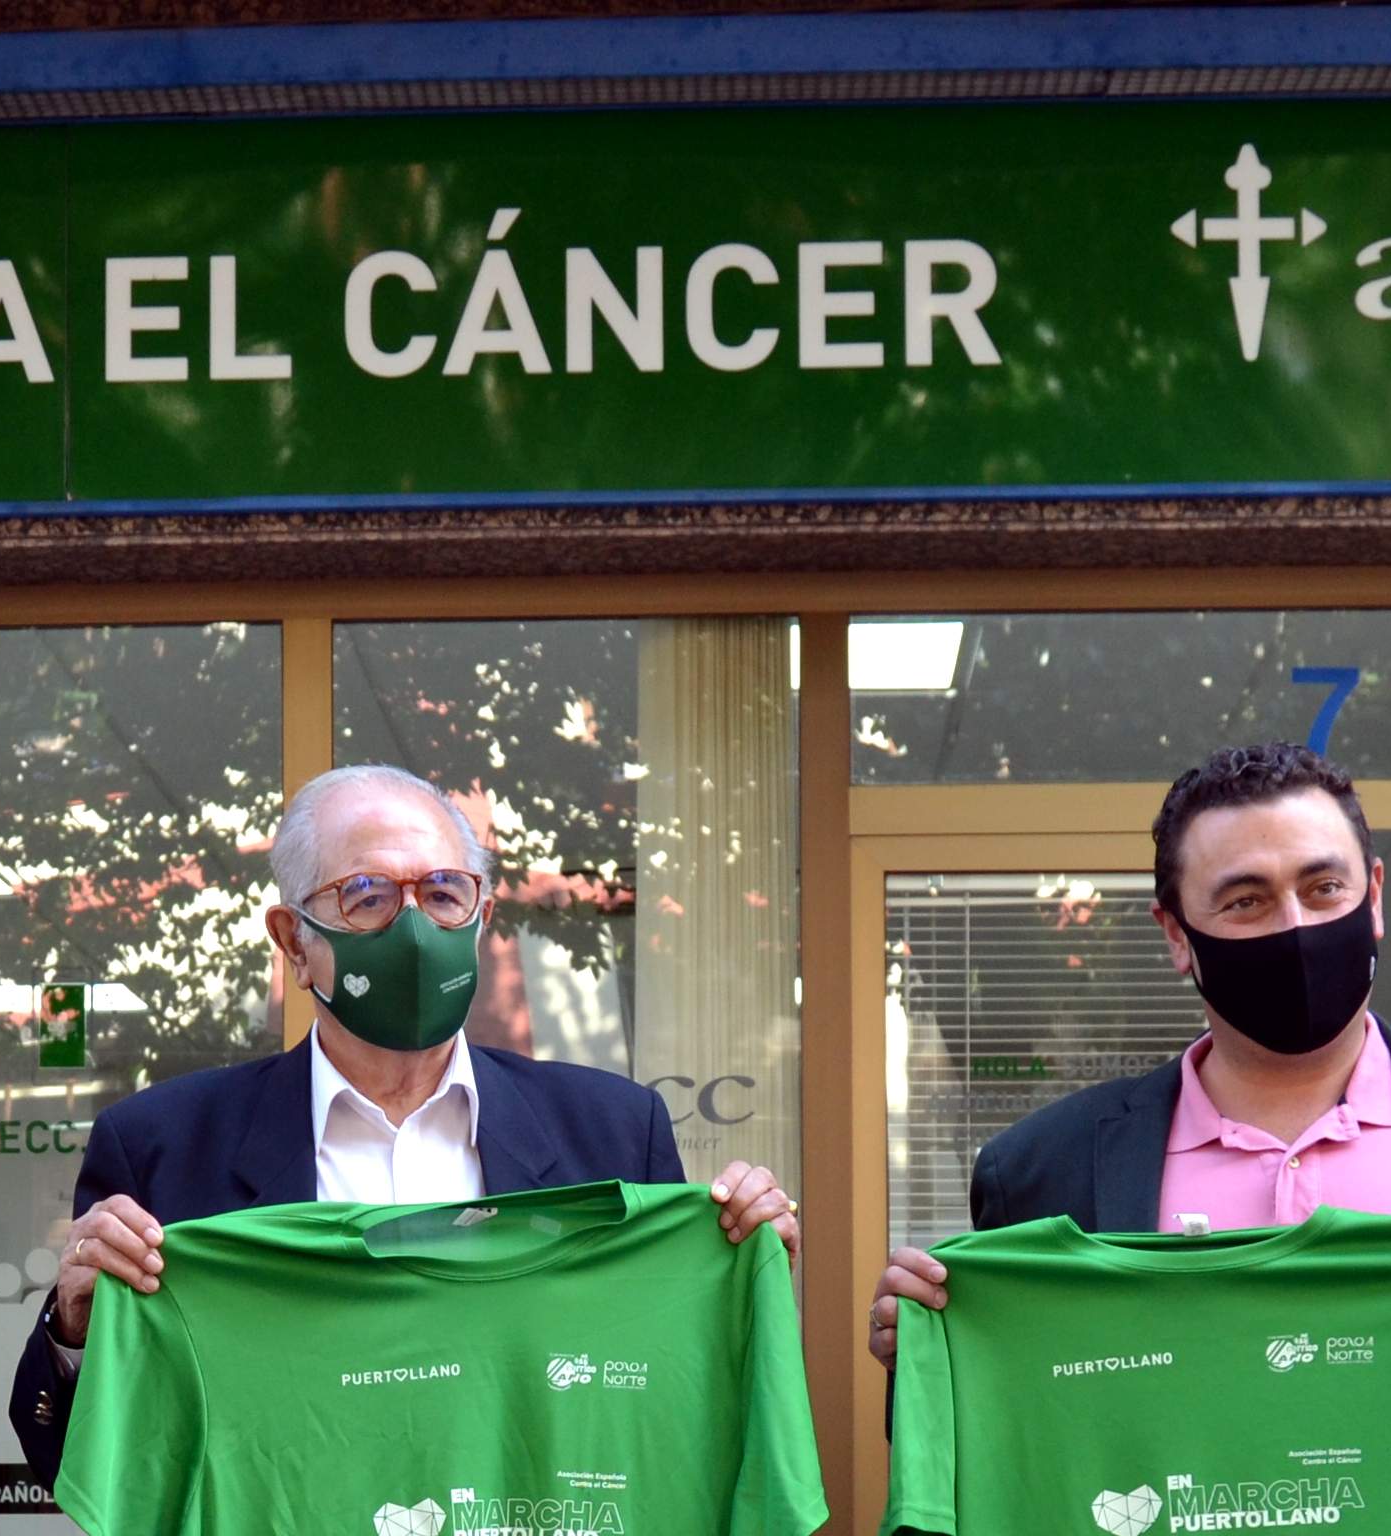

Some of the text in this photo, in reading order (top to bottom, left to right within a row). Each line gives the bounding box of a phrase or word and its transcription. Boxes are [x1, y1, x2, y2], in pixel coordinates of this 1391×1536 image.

[105, 256, 292, 383] EL
[344, 207, 1003, 378] CÁNCER
[1292, 666, 1360, 756] 7
[450, 1487, 475, 1503] EN
[1166, 1473, 1193, 1491] EN
[1167, 1476, 1365, 1521] MARCHA
[451, 1498, 625, 1536] MARCHA
[1170, 1506, 1341, 1534] PUERTOLLANO
